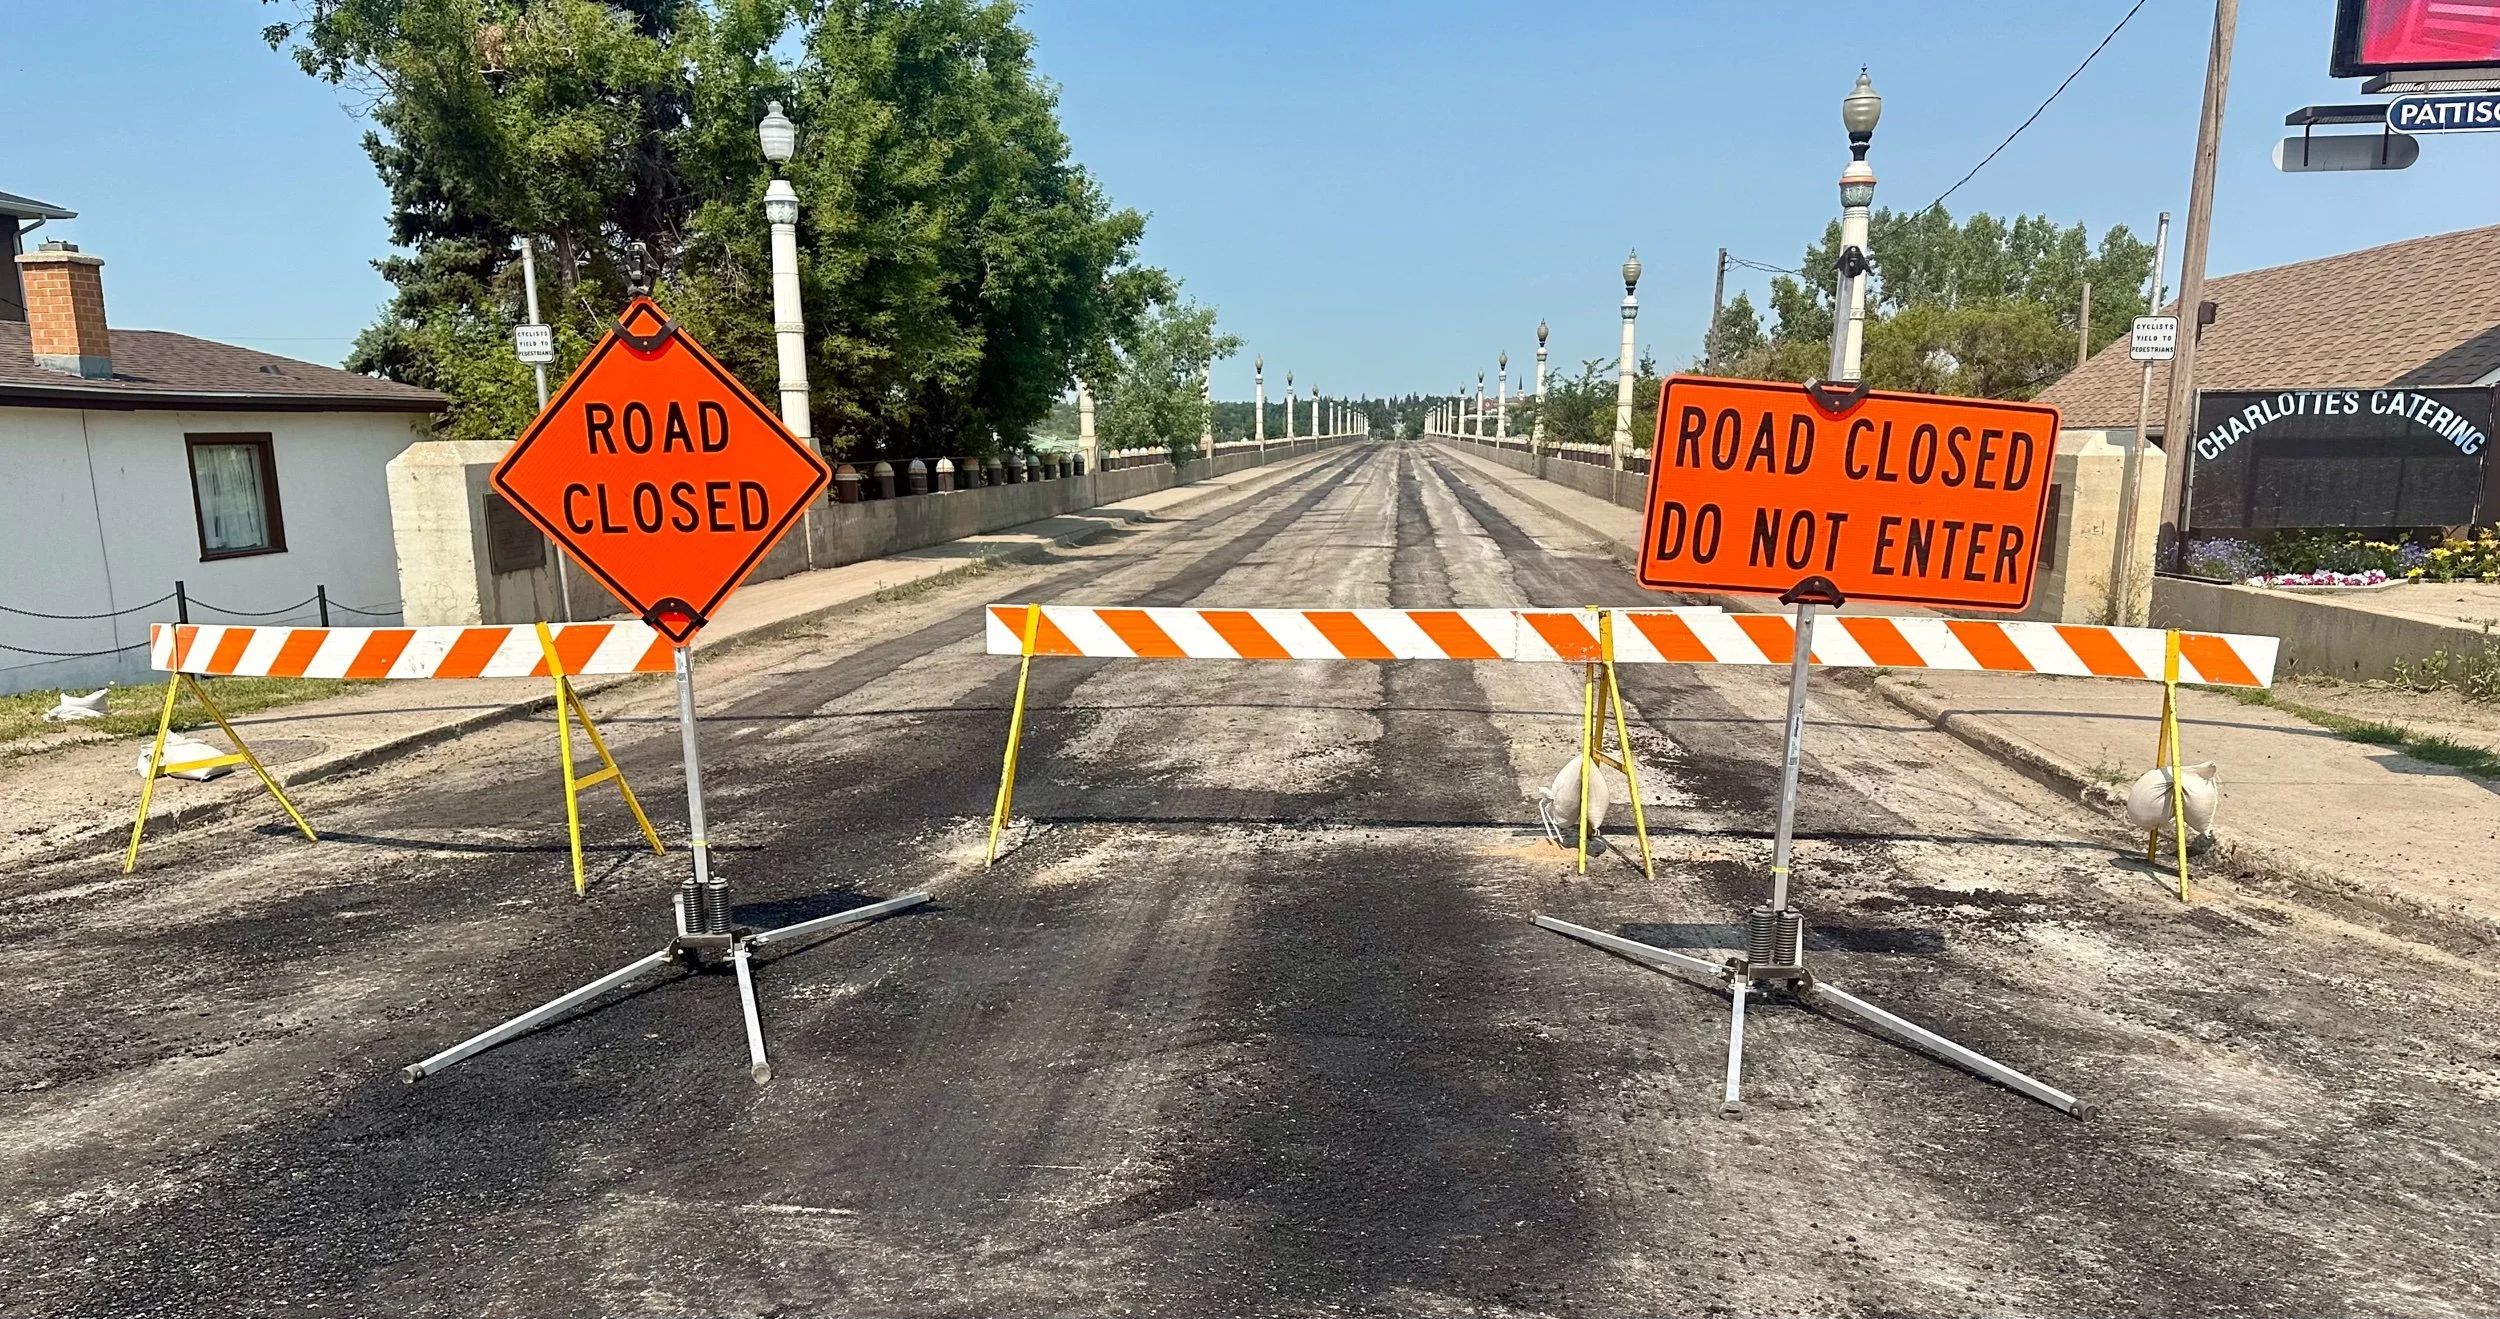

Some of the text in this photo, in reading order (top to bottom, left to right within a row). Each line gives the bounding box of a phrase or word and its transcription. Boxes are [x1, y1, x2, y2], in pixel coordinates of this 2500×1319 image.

[584, 401, 729, 454] ROAD
[1675, 405, 2034, 492] ROAD CLOSED
[2197, 390, 2486, 460] CHARLOTTE'S CATERING
[562, 481, 769, 535] CLOSED
[1656, 501, 2024, 585] DO NOT ENTER
